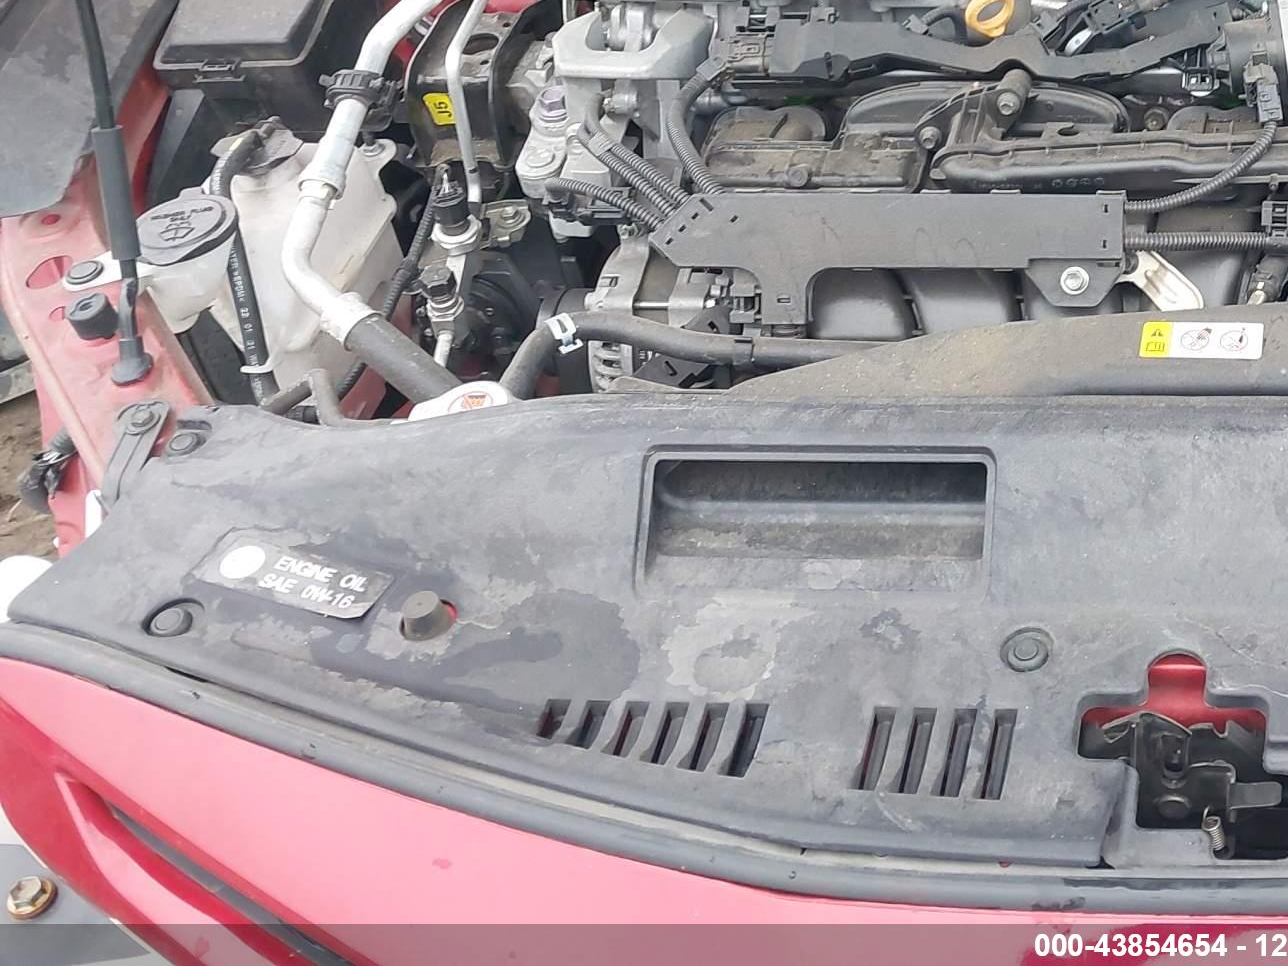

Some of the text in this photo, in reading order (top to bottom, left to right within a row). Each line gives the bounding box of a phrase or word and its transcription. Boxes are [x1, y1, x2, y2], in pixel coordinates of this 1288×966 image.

[434, 101, 452, 117] J5
[258, 573, 356, 609] SAE 0W-16
[273, 556, 368, 592] ENGINE OIL
